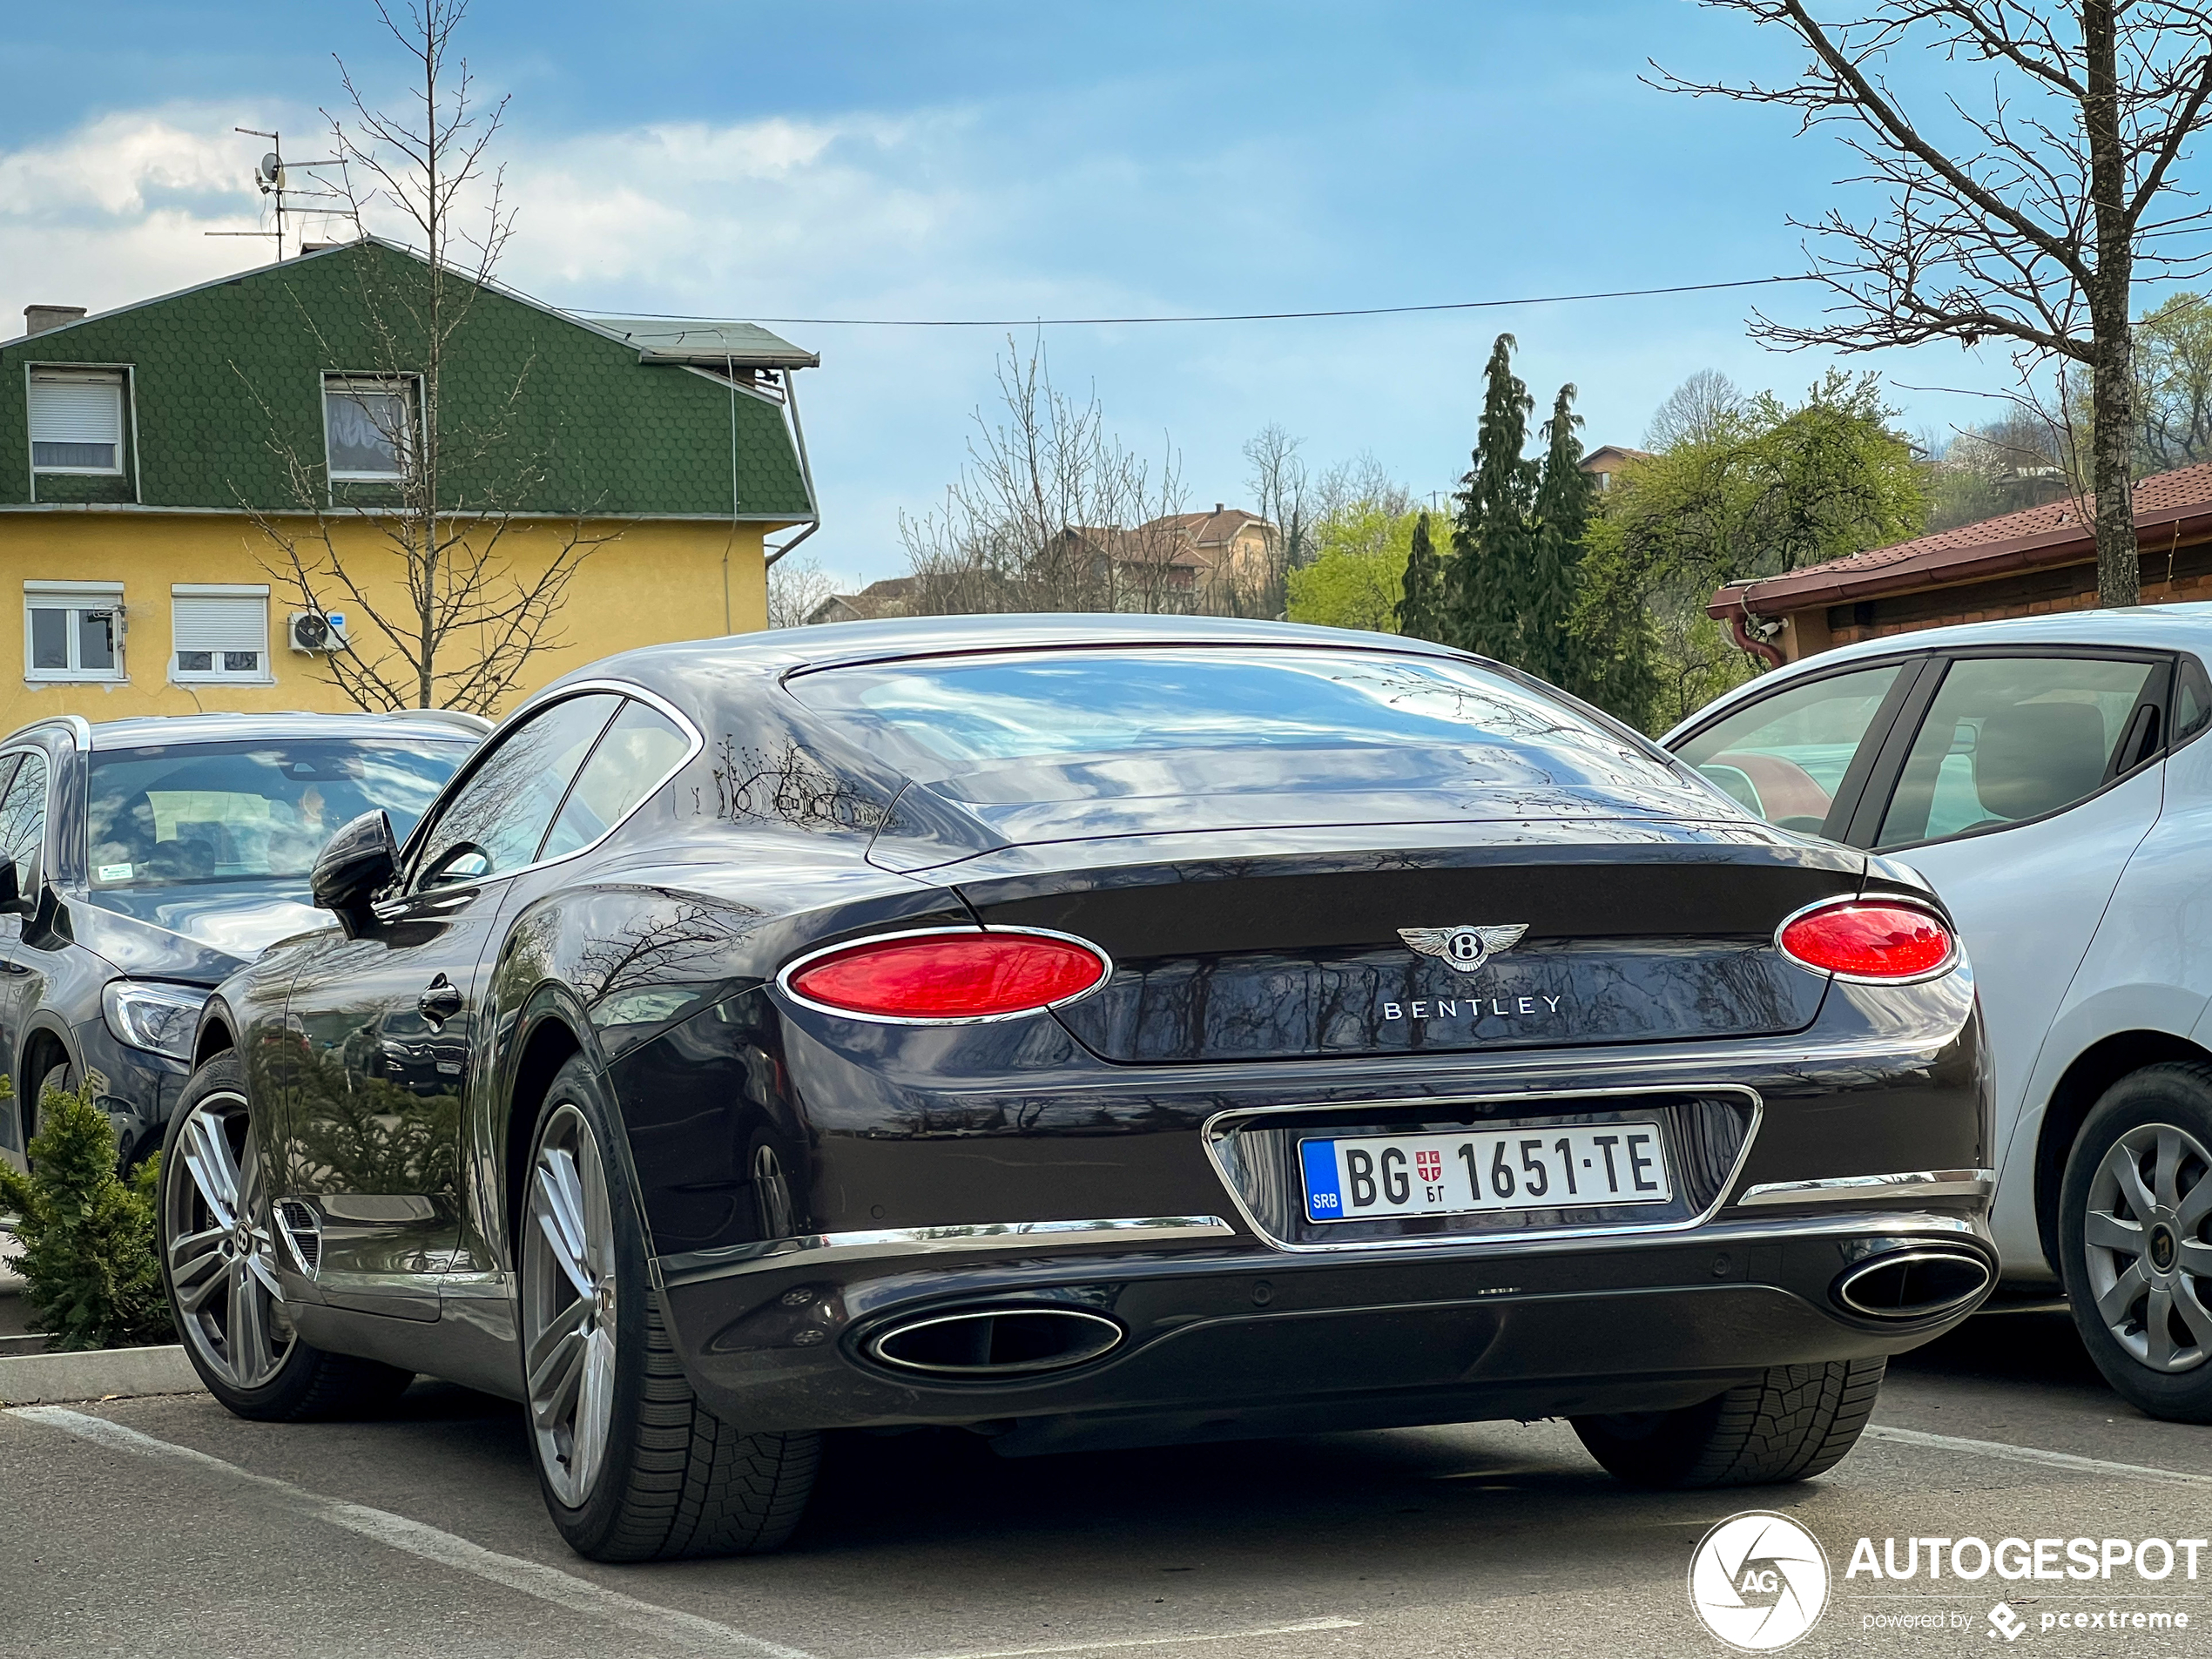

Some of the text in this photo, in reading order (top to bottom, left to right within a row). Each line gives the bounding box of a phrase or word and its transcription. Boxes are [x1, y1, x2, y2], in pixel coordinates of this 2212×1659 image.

[1454, 936, 1479, 959] B
[1384, 995, 1561, 1020] BENTLEY
[1346, 1147, 1410, 1207] BG
[1312, 1193, 1339, 1209] SRB
